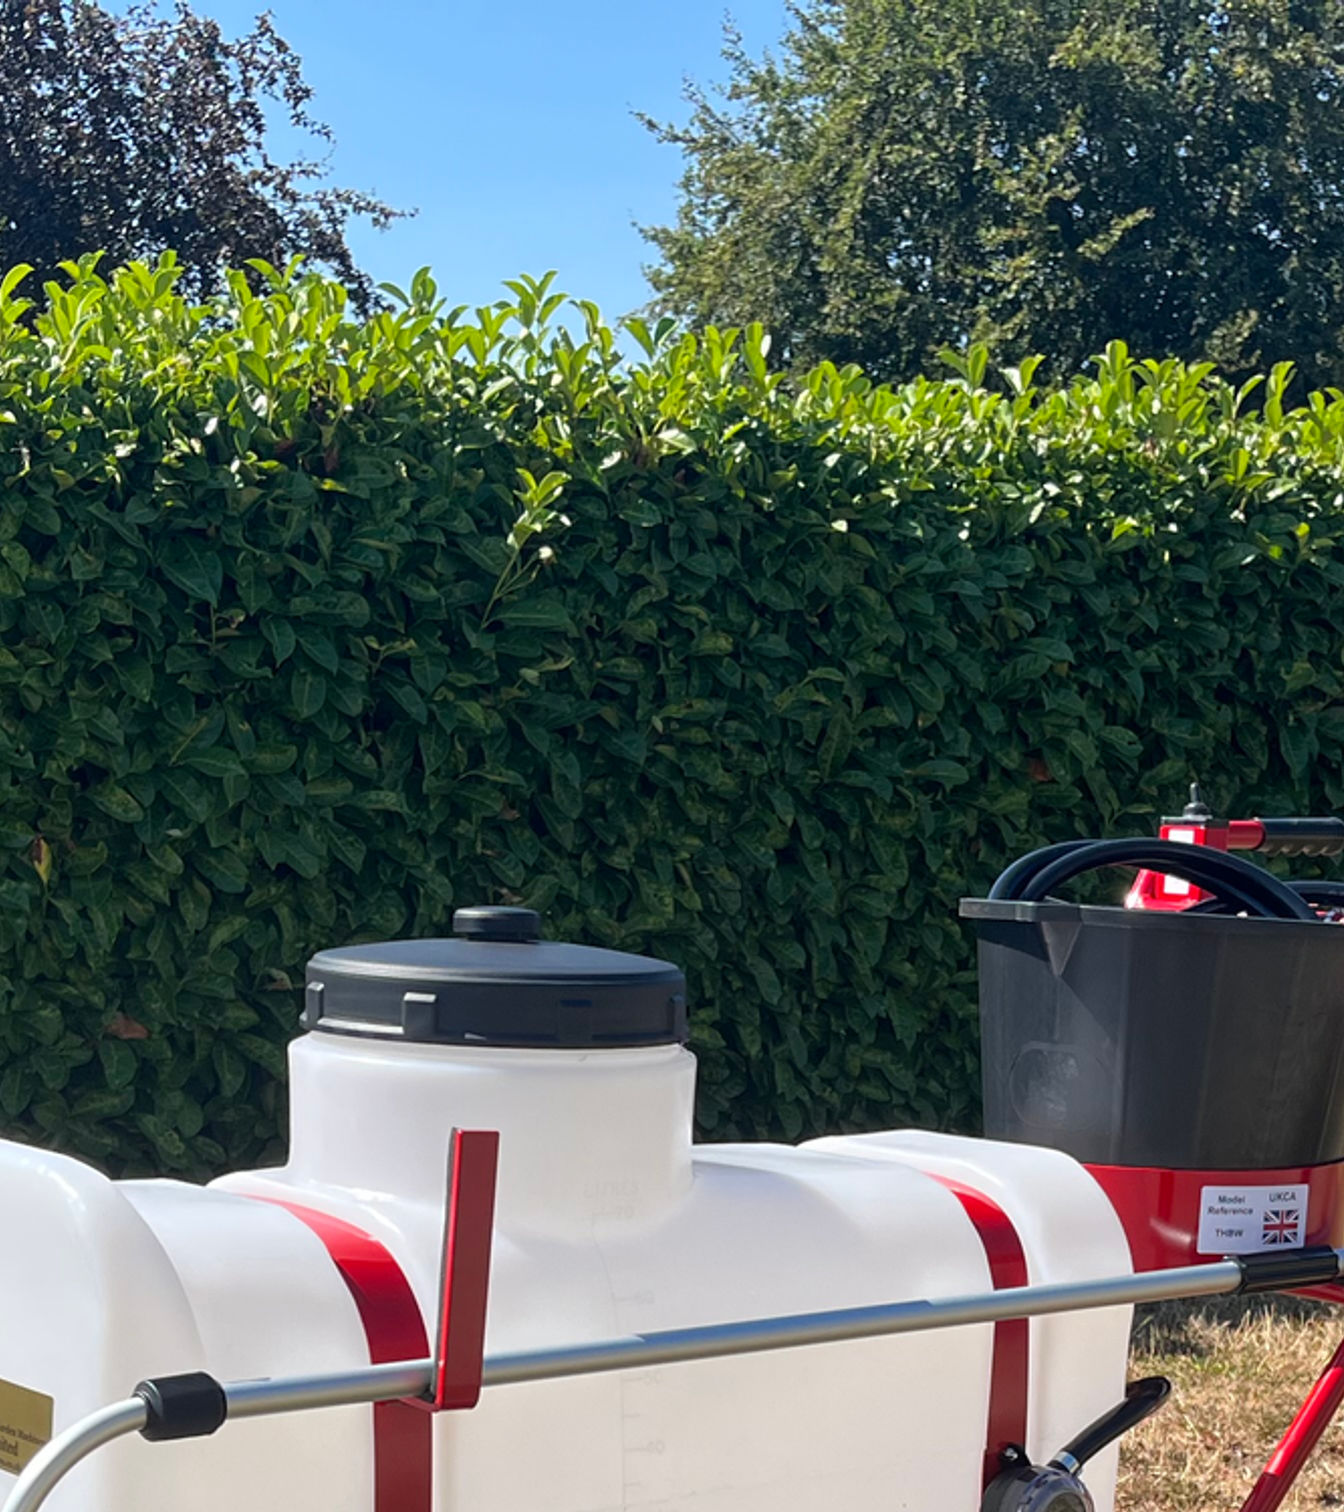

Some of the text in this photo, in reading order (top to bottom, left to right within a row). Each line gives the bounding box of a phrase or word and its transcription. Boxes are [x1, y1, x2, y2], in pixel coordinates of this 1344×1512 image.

[1218, 1195, 1246, 1204] Model
[1268, 1191, 1296, 1203] UKCA
[1208, 1206, 1254, 1216] Reference
